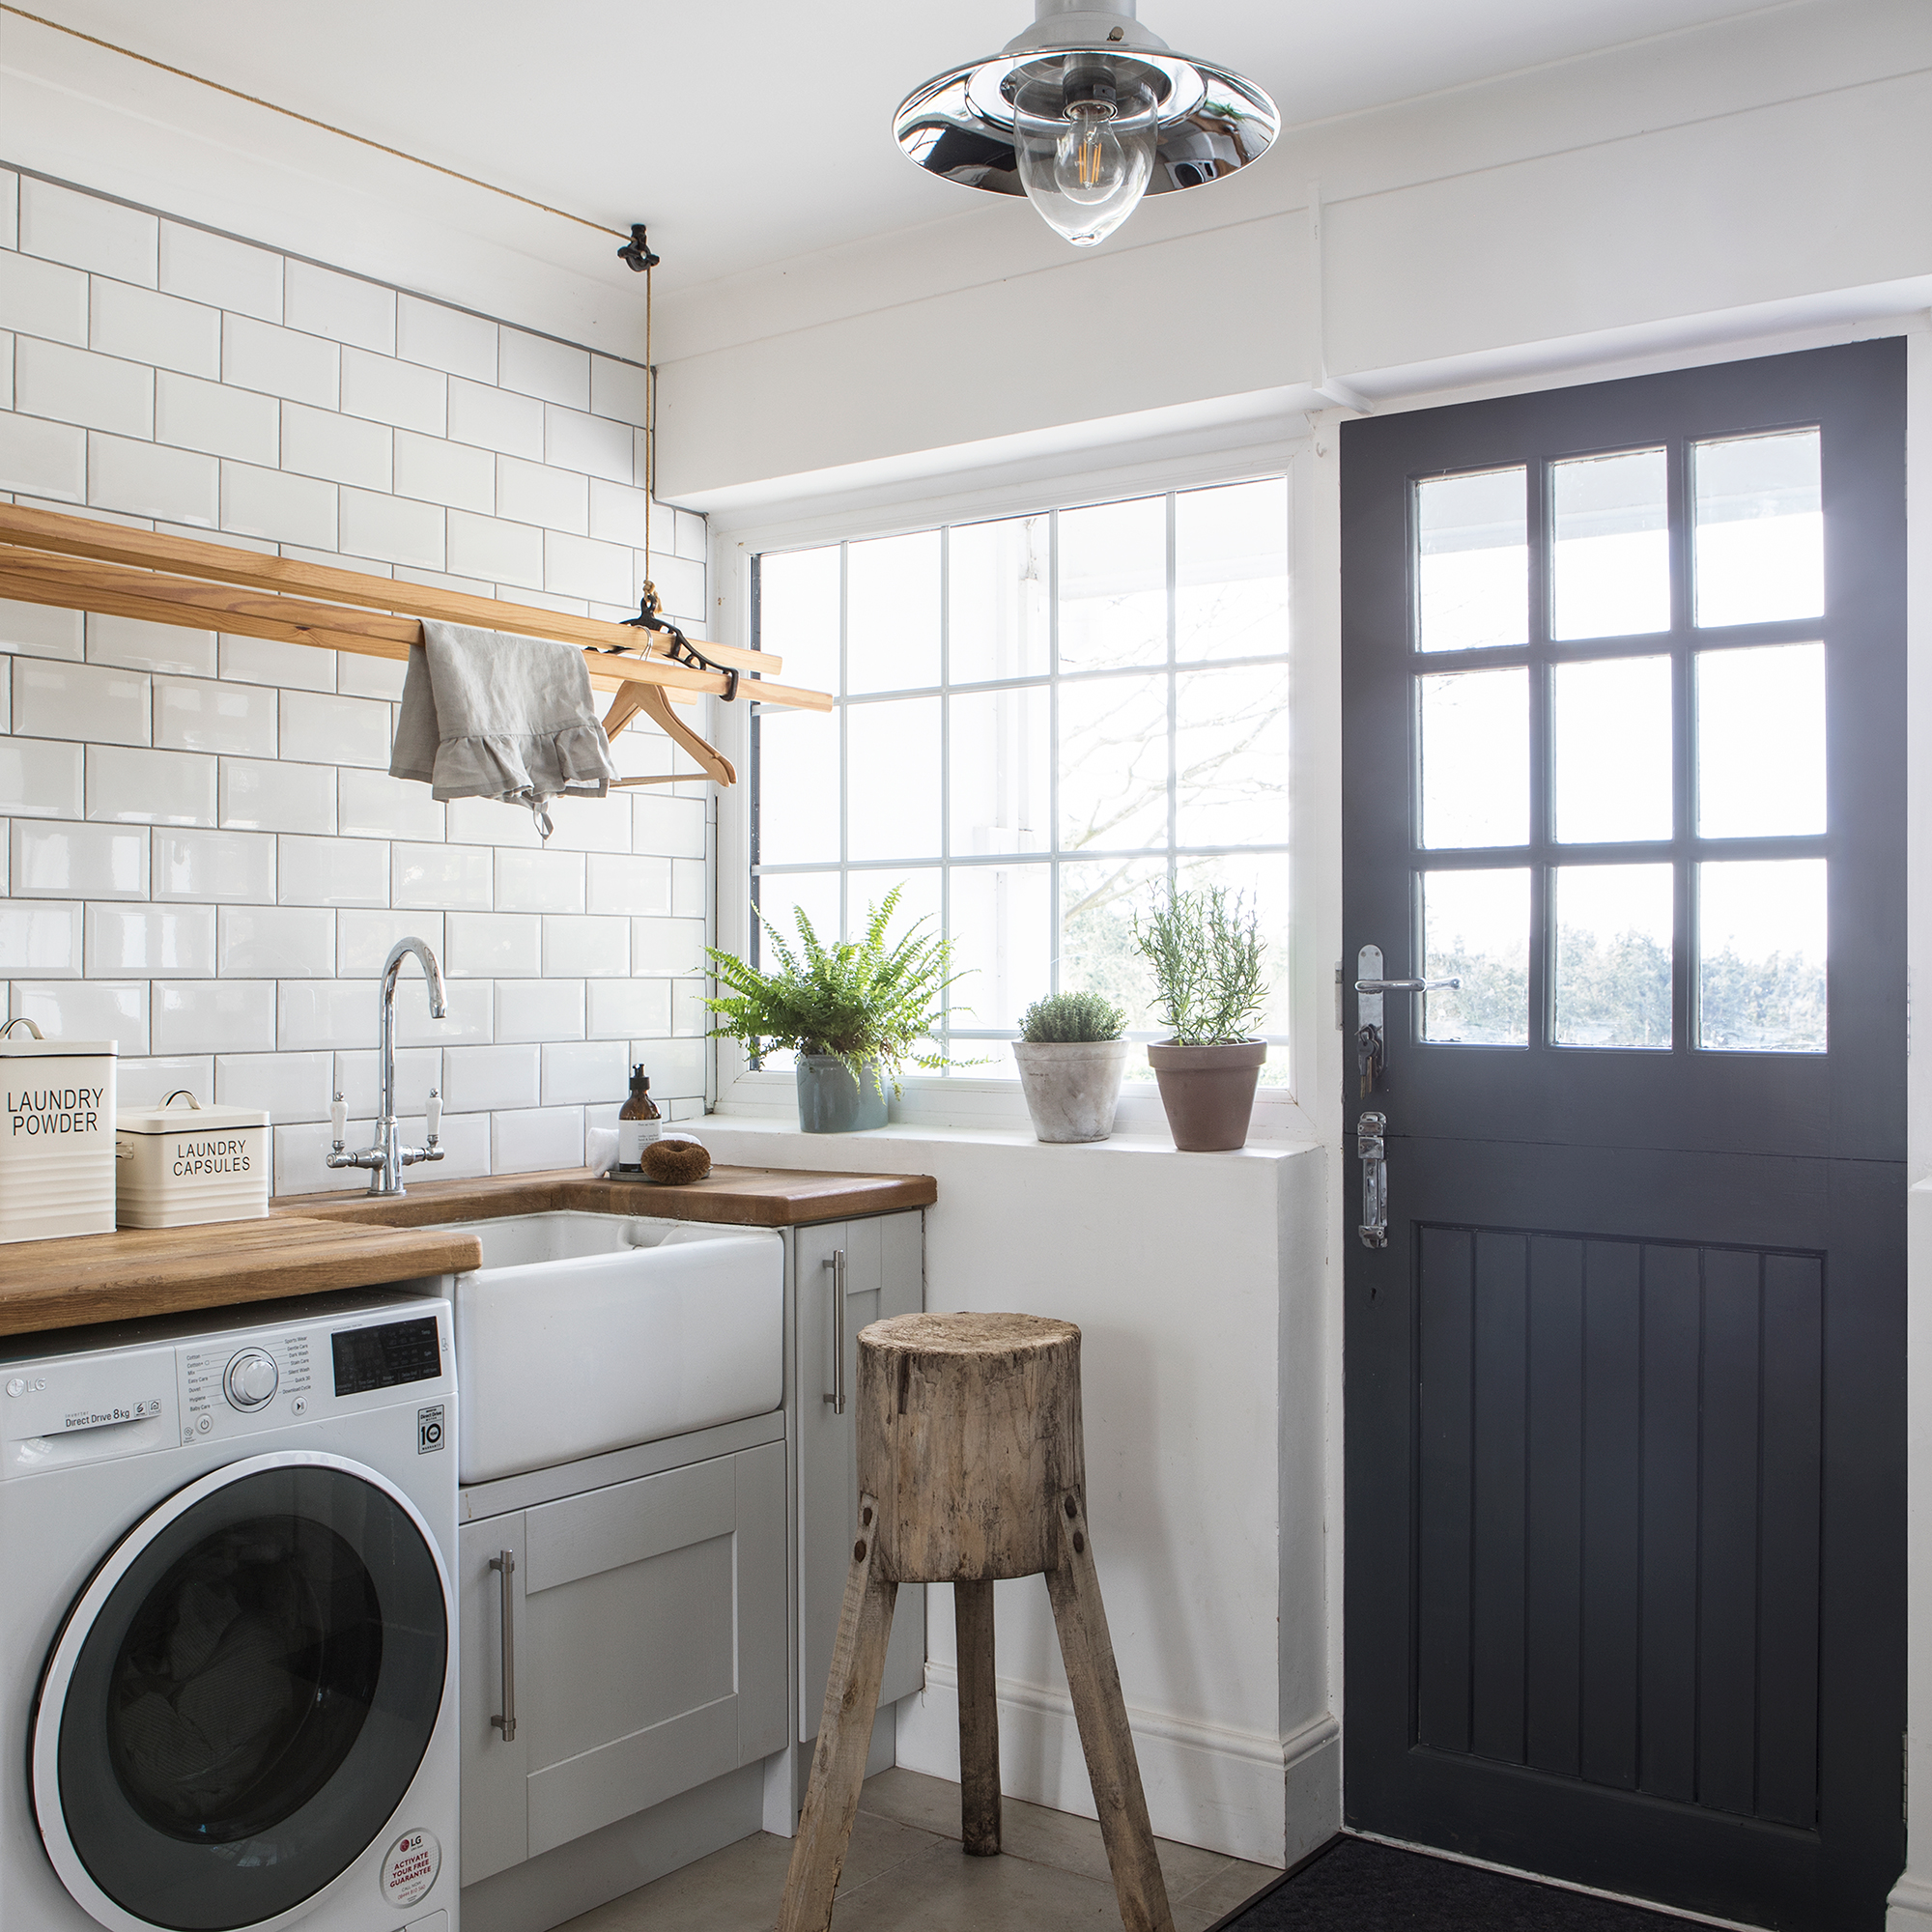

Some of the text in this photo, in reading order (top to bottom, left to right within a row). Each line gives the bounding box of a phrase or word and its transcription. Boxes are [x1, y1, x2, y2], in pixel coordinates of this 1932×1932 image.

[8, 1088, 103, 1112] LAUNDRY
[13, 1112, 99, 1136] POWDER
[178, 1140, 246, 1158] LAUNDRY
[173, 1156, 250, 1176] CAPSULES
[26, 1378, 46, 1393] LG
[66, 1416, 90, 1427] Direct
[91, 1413, 112, 1423] Drive
[421, 1423, 441, 1445] 10
[411, 1835, 422, 1847] LG
[392, 1859, 430, 1878] YOUR FREE
[394, 1851, 429, 1870] ACTIVATE
[389, 1865, 432, 1888] GUARANTEE
